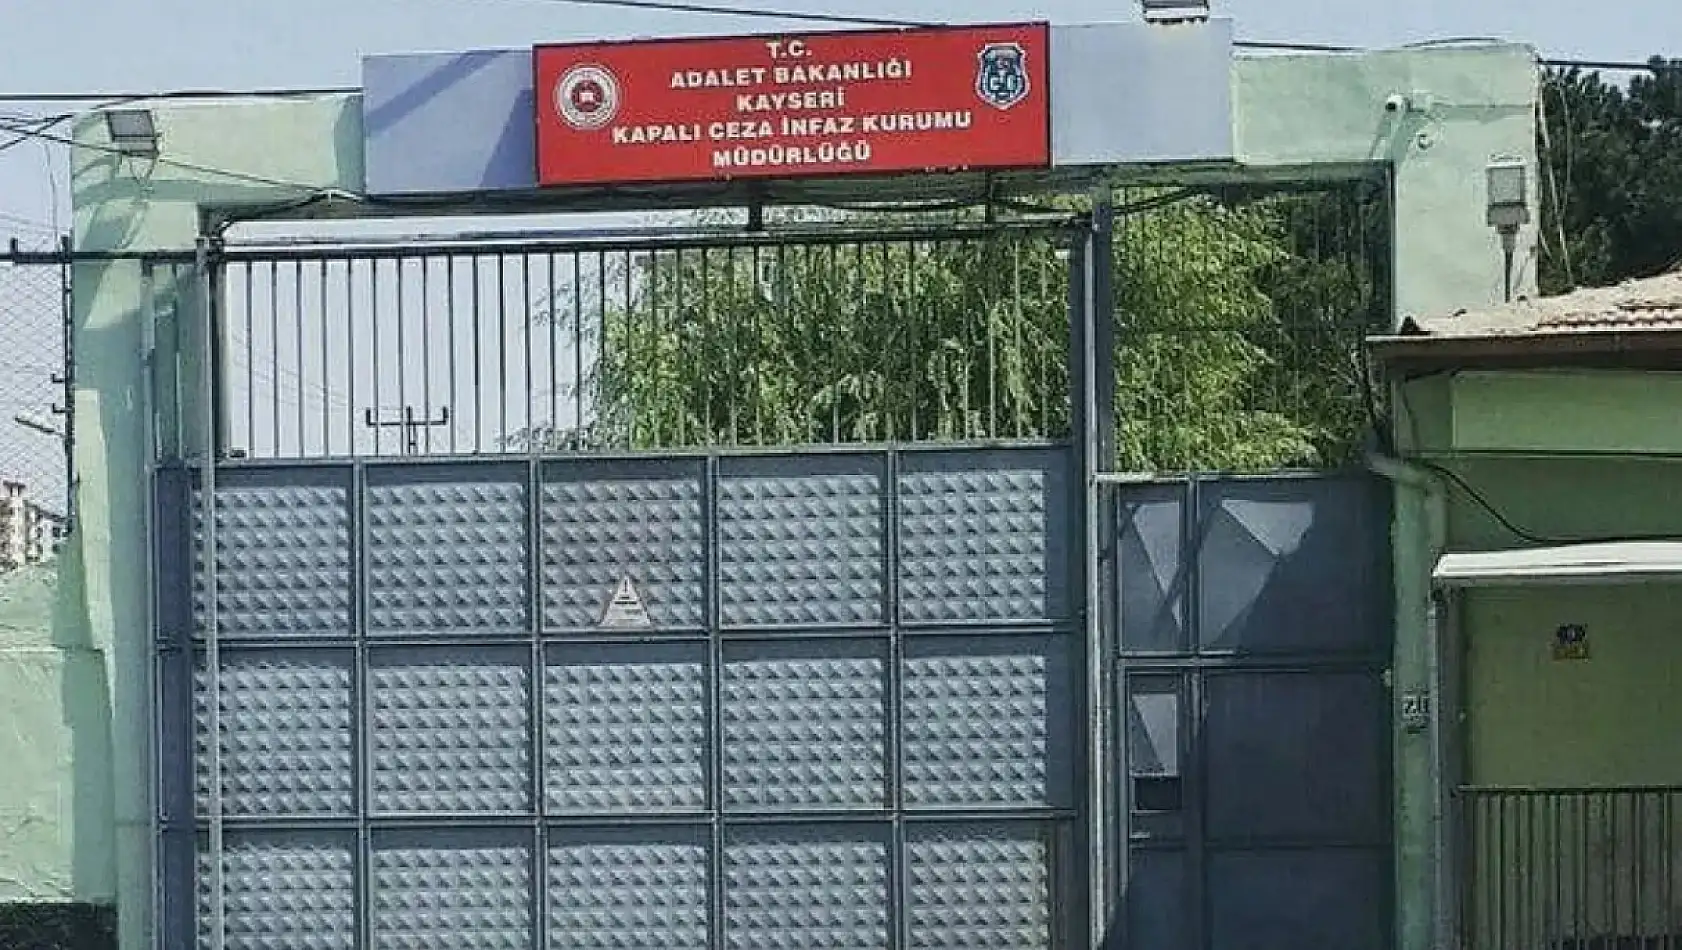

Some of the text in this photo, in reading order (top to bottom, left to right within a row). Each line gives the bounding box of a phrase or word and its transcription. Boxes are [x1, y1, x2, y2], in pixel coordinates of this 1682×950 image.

[766, 40, 812, 59] T.C.
[671, 58, 911, 88] ADALET BAKANLIĞI
[737, 86, 844, 112] KAYSERİ
[613, 111, 971, 144] KAPALI CEZA İNFAZ KURUMU
[713, 140, 871, 168] MÜDÜRLÜĞÜ
